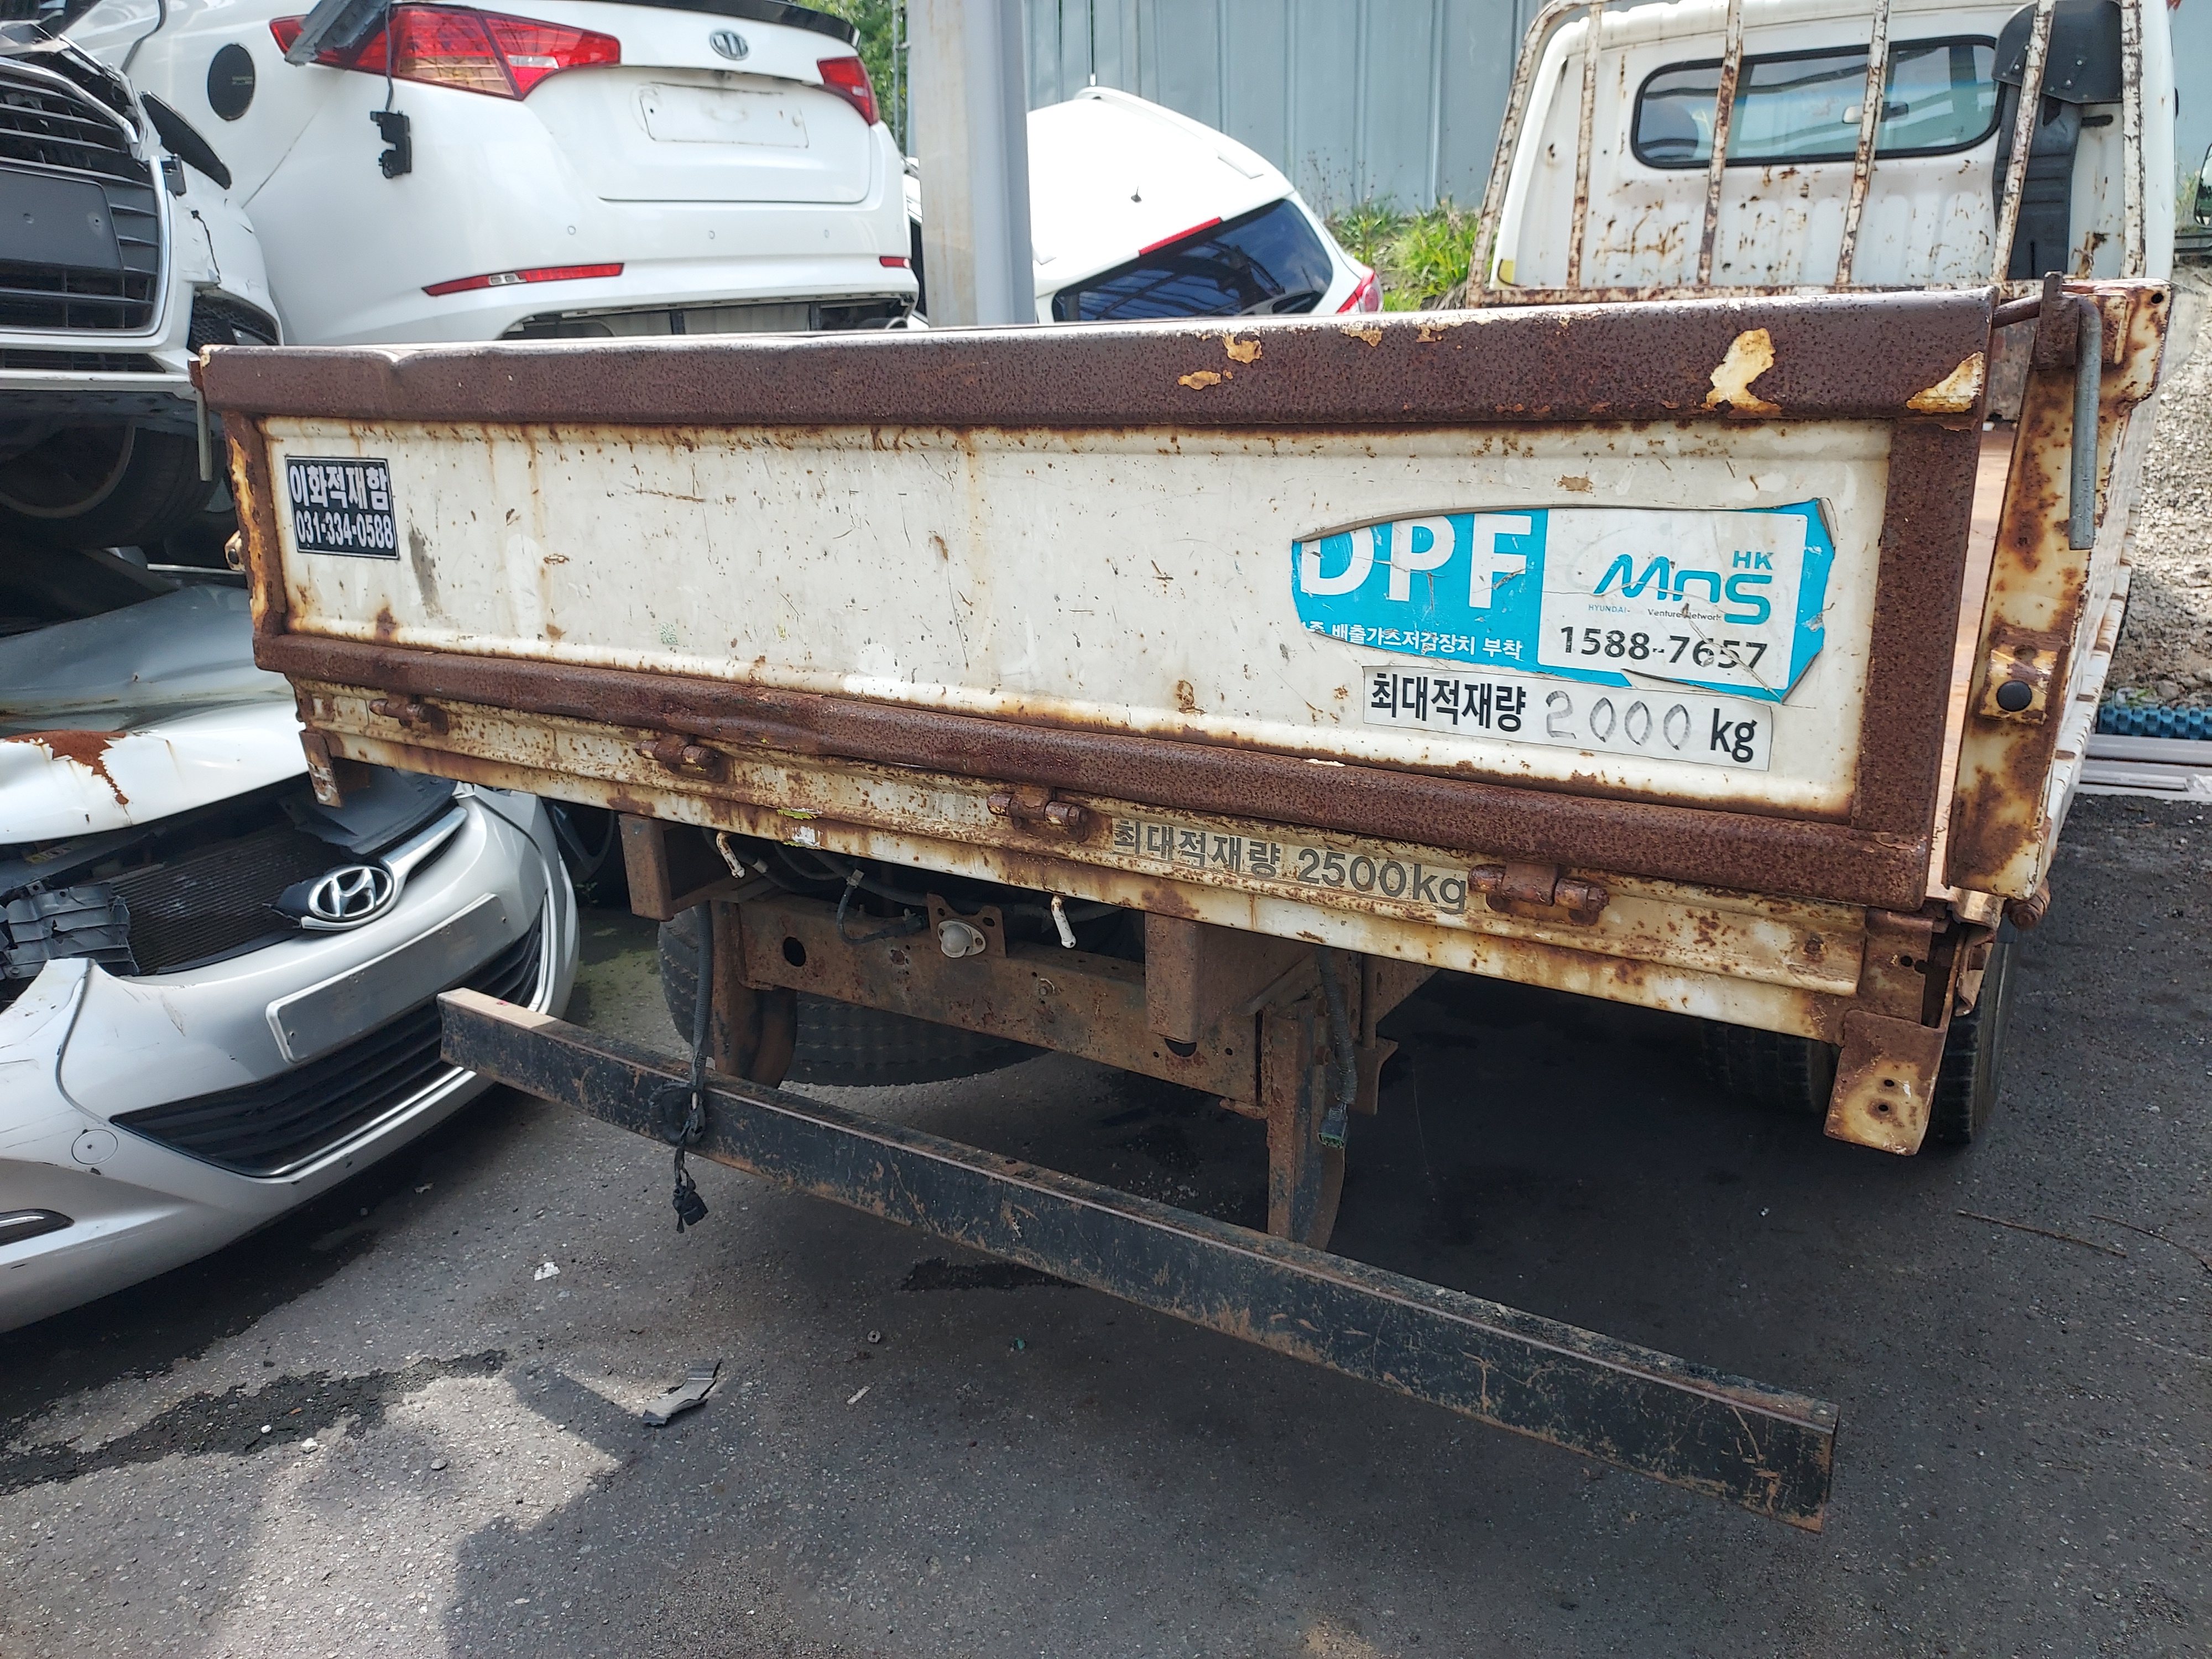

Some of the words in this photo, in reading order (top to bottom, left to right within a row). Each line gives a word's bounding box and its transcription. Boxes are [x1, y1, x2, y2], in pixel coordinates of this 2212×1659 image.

[289, 465, 389, 510] 이화적재함
[296, 510, 394, 549] 031-334-0588
[1300, 513, 1531, 609] DPF
[1732, 550, 1773, 570] HK
[1482, 638, 1524, 661] 부착
[1560, 626, 1767, 669] 1588-7657
[1370, 673, 1526, 732] 최대적재량
[1546, 690, 1692, 750] 2000
[1710, 708, 1757, 763] kg
[1113, 820, 1280, 878] 최대적재량
[1297, 848, 1467, 915] 2500kg
